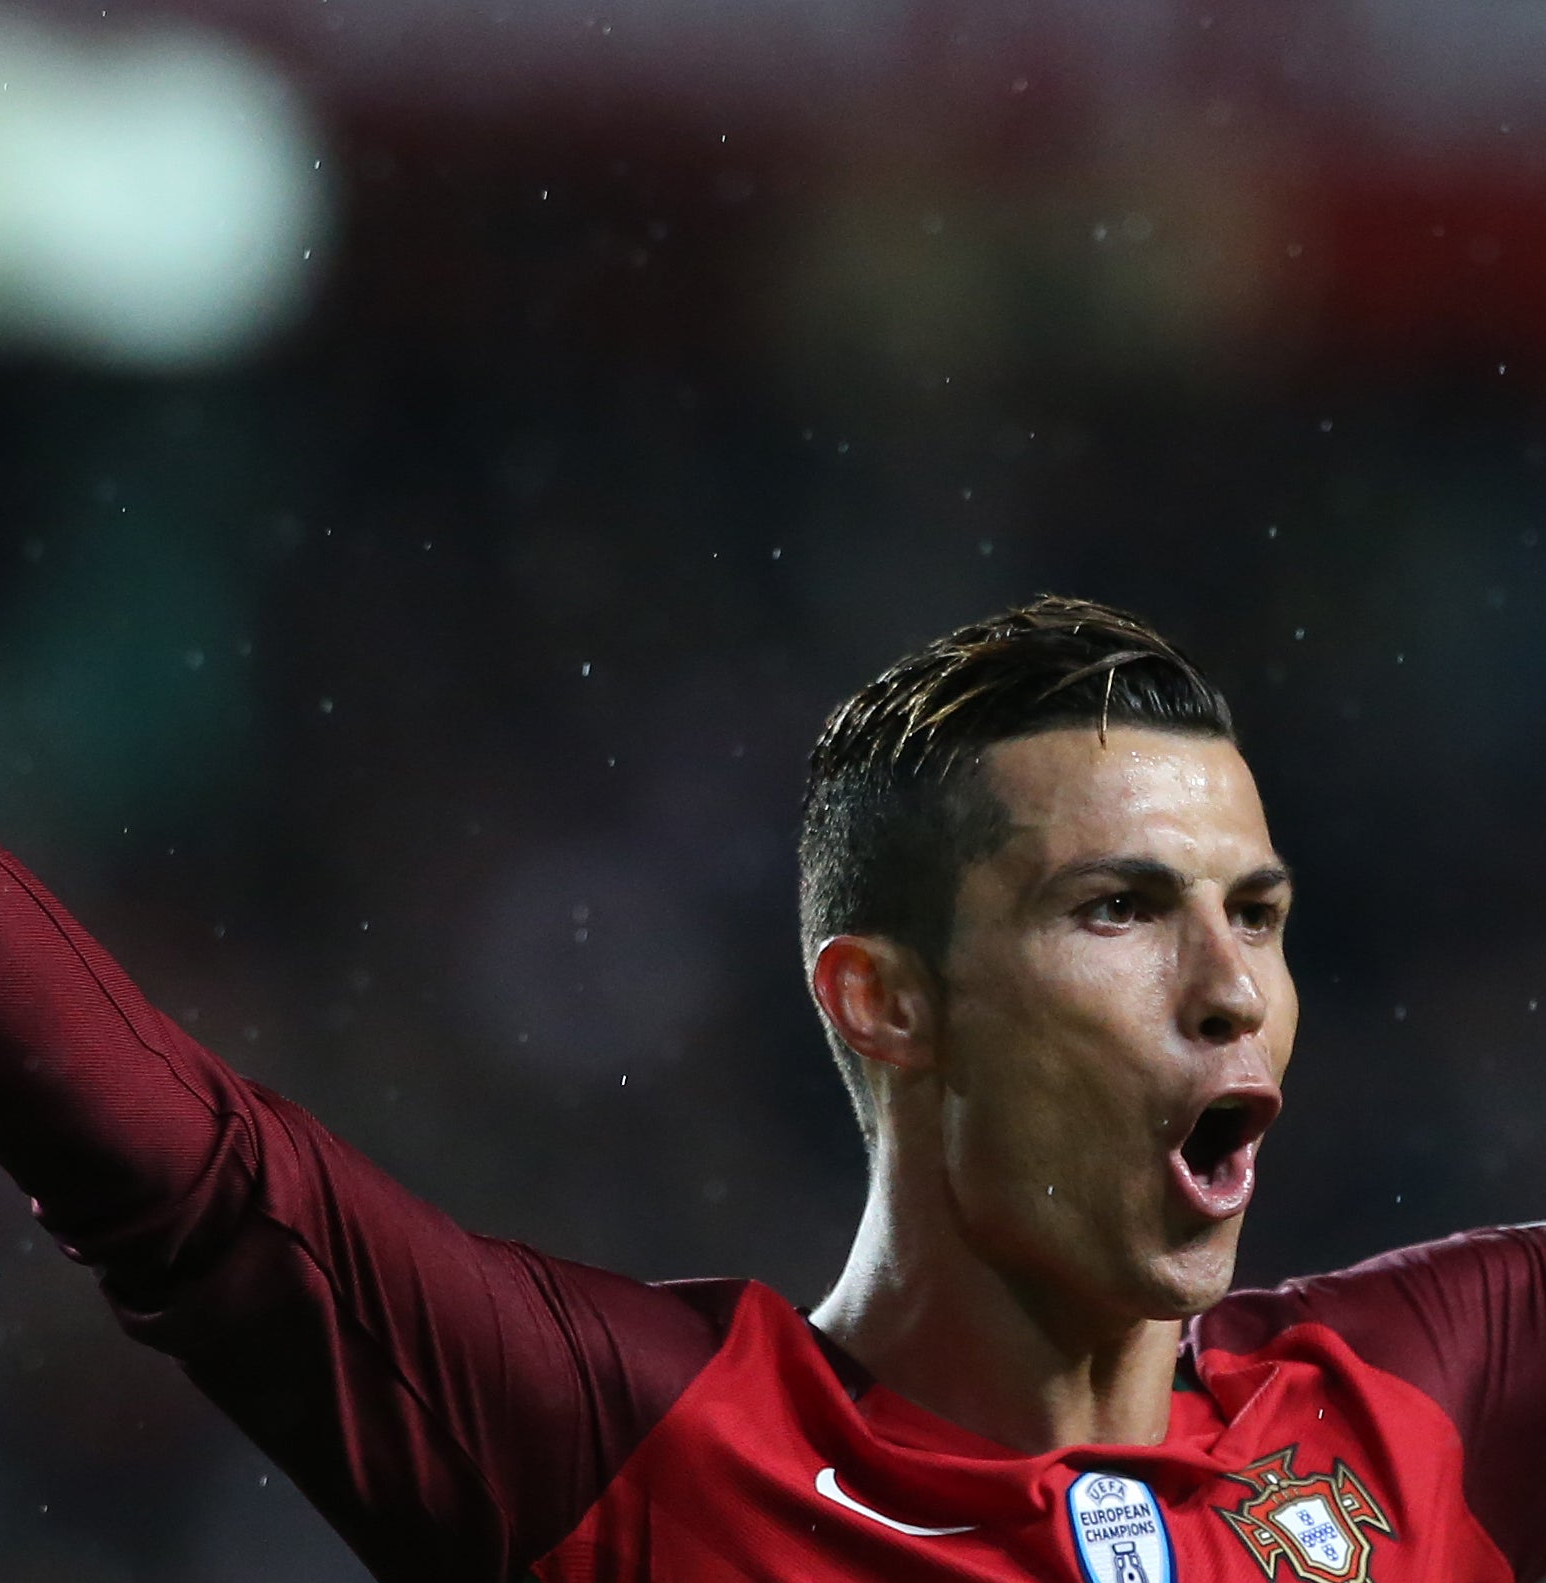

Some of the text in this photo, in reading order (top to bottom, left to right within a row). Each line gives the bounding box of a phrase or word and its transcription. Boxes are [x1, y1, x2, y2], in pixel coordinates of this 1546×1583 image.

[1089, 1480, 1125, 1501] UEFA
[1080, 1503, 1151, 1526] EUROPEAN
[1085, 1520, 1156, 1543] CHAMPIONS
